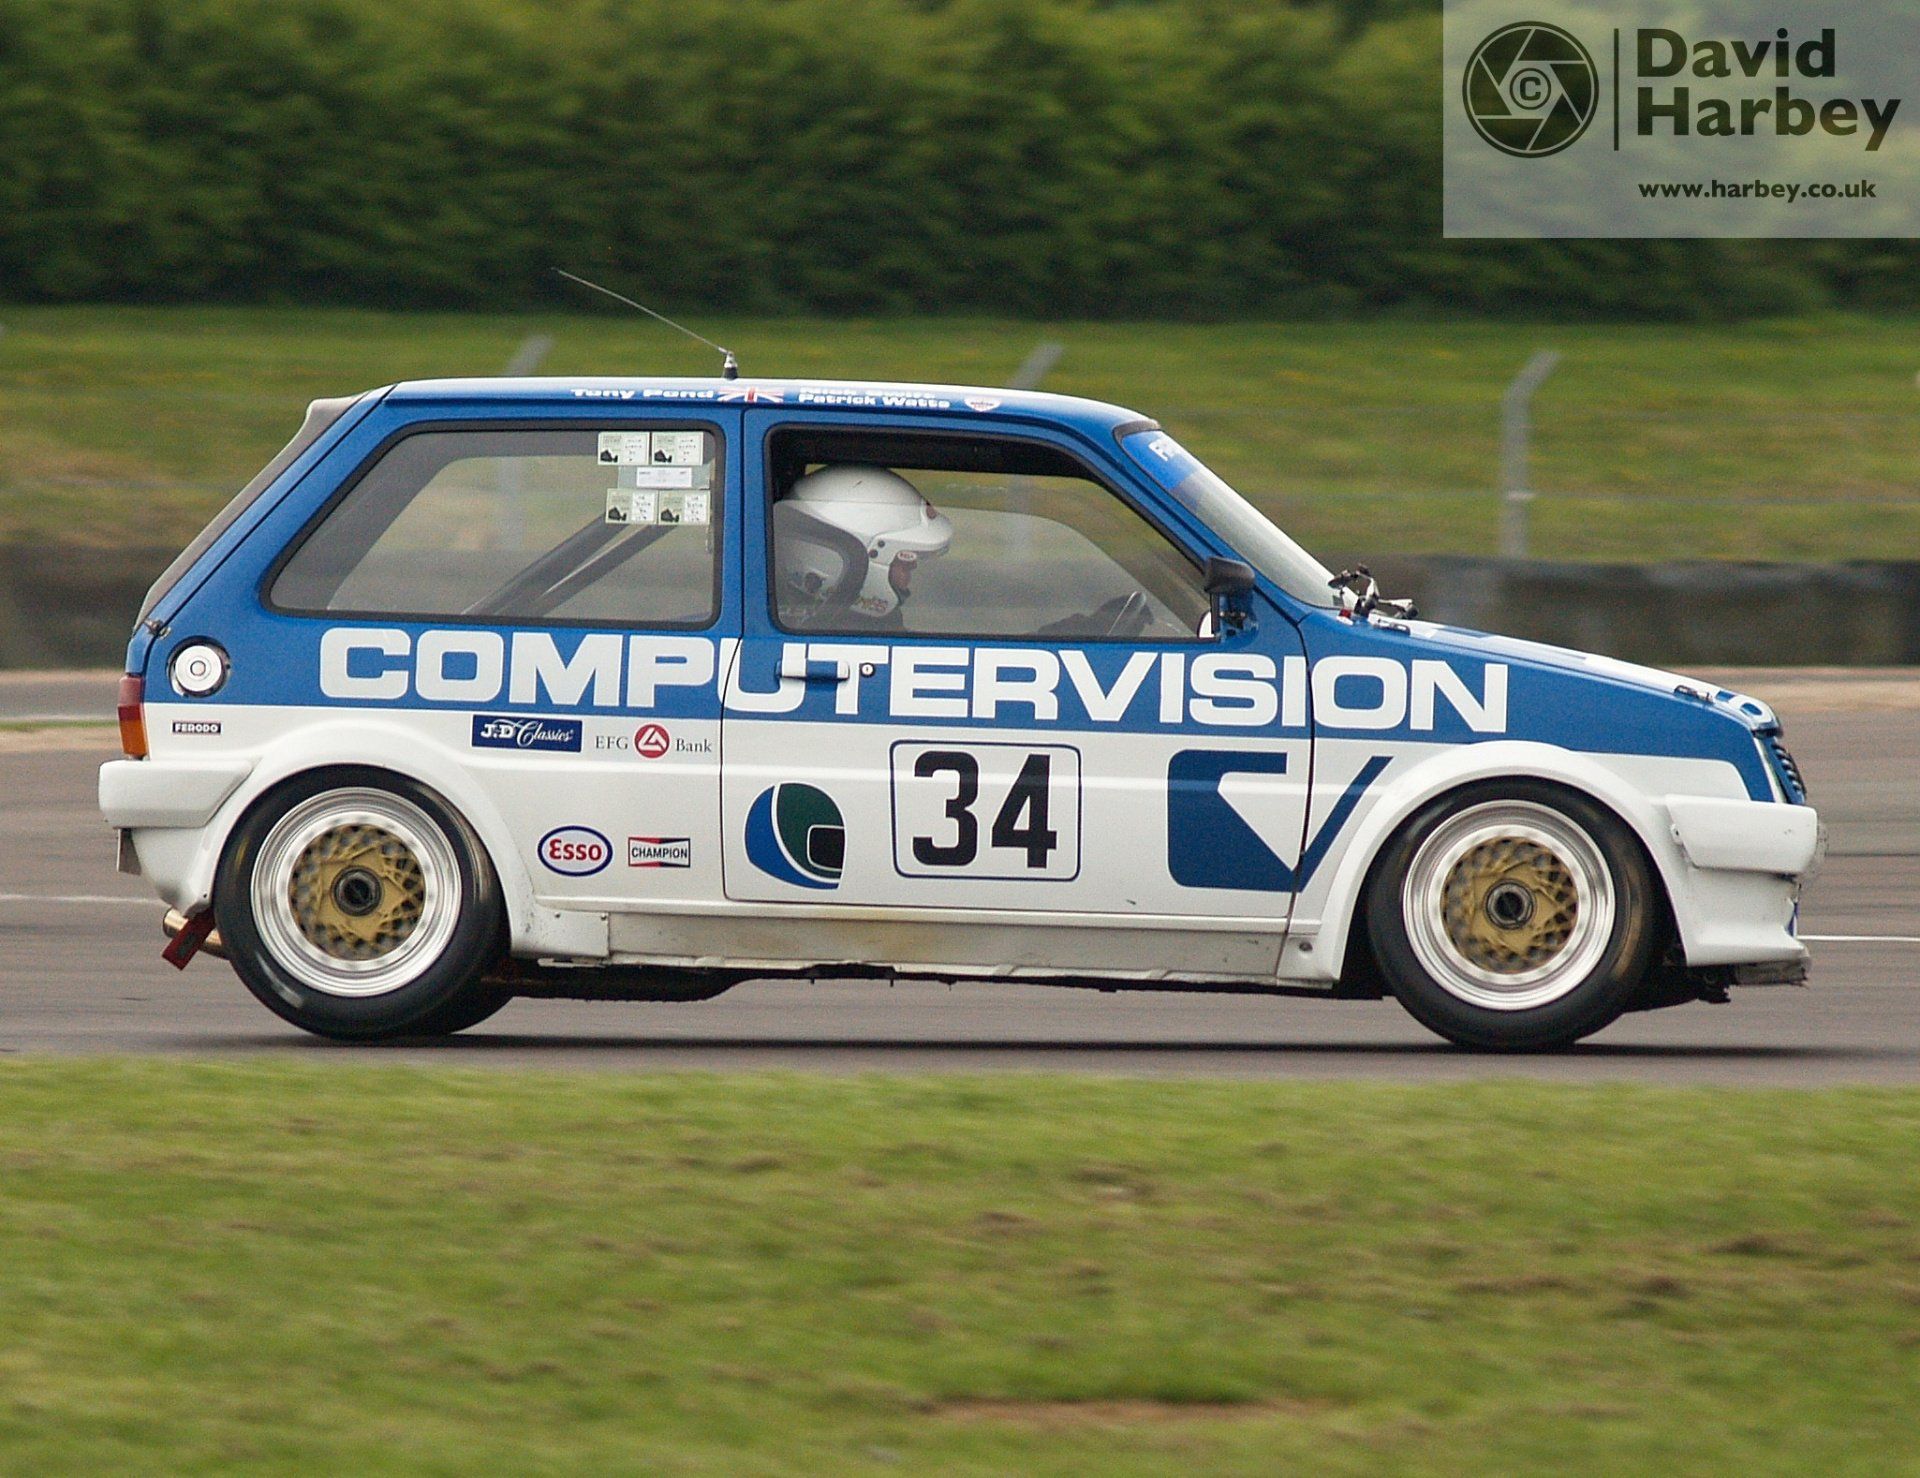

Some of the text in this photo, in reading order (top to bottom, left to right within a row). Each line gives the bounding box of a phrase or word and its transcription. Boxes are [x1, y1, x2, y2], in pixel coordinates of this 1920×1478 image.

[642, 388, 714, 399] Pond
[798, 392, 877, 406] Patrick
[319, 626, 1509, 734] COMPUTERVISION
[173, 722, 219, 734] FERODO
[515, 720, 574, 748] Classics
[595, 735, 713, 753] EFG Bank
[911, 749, 1058, 870] 34
[631, 846, 688, 859] CHAMPION
